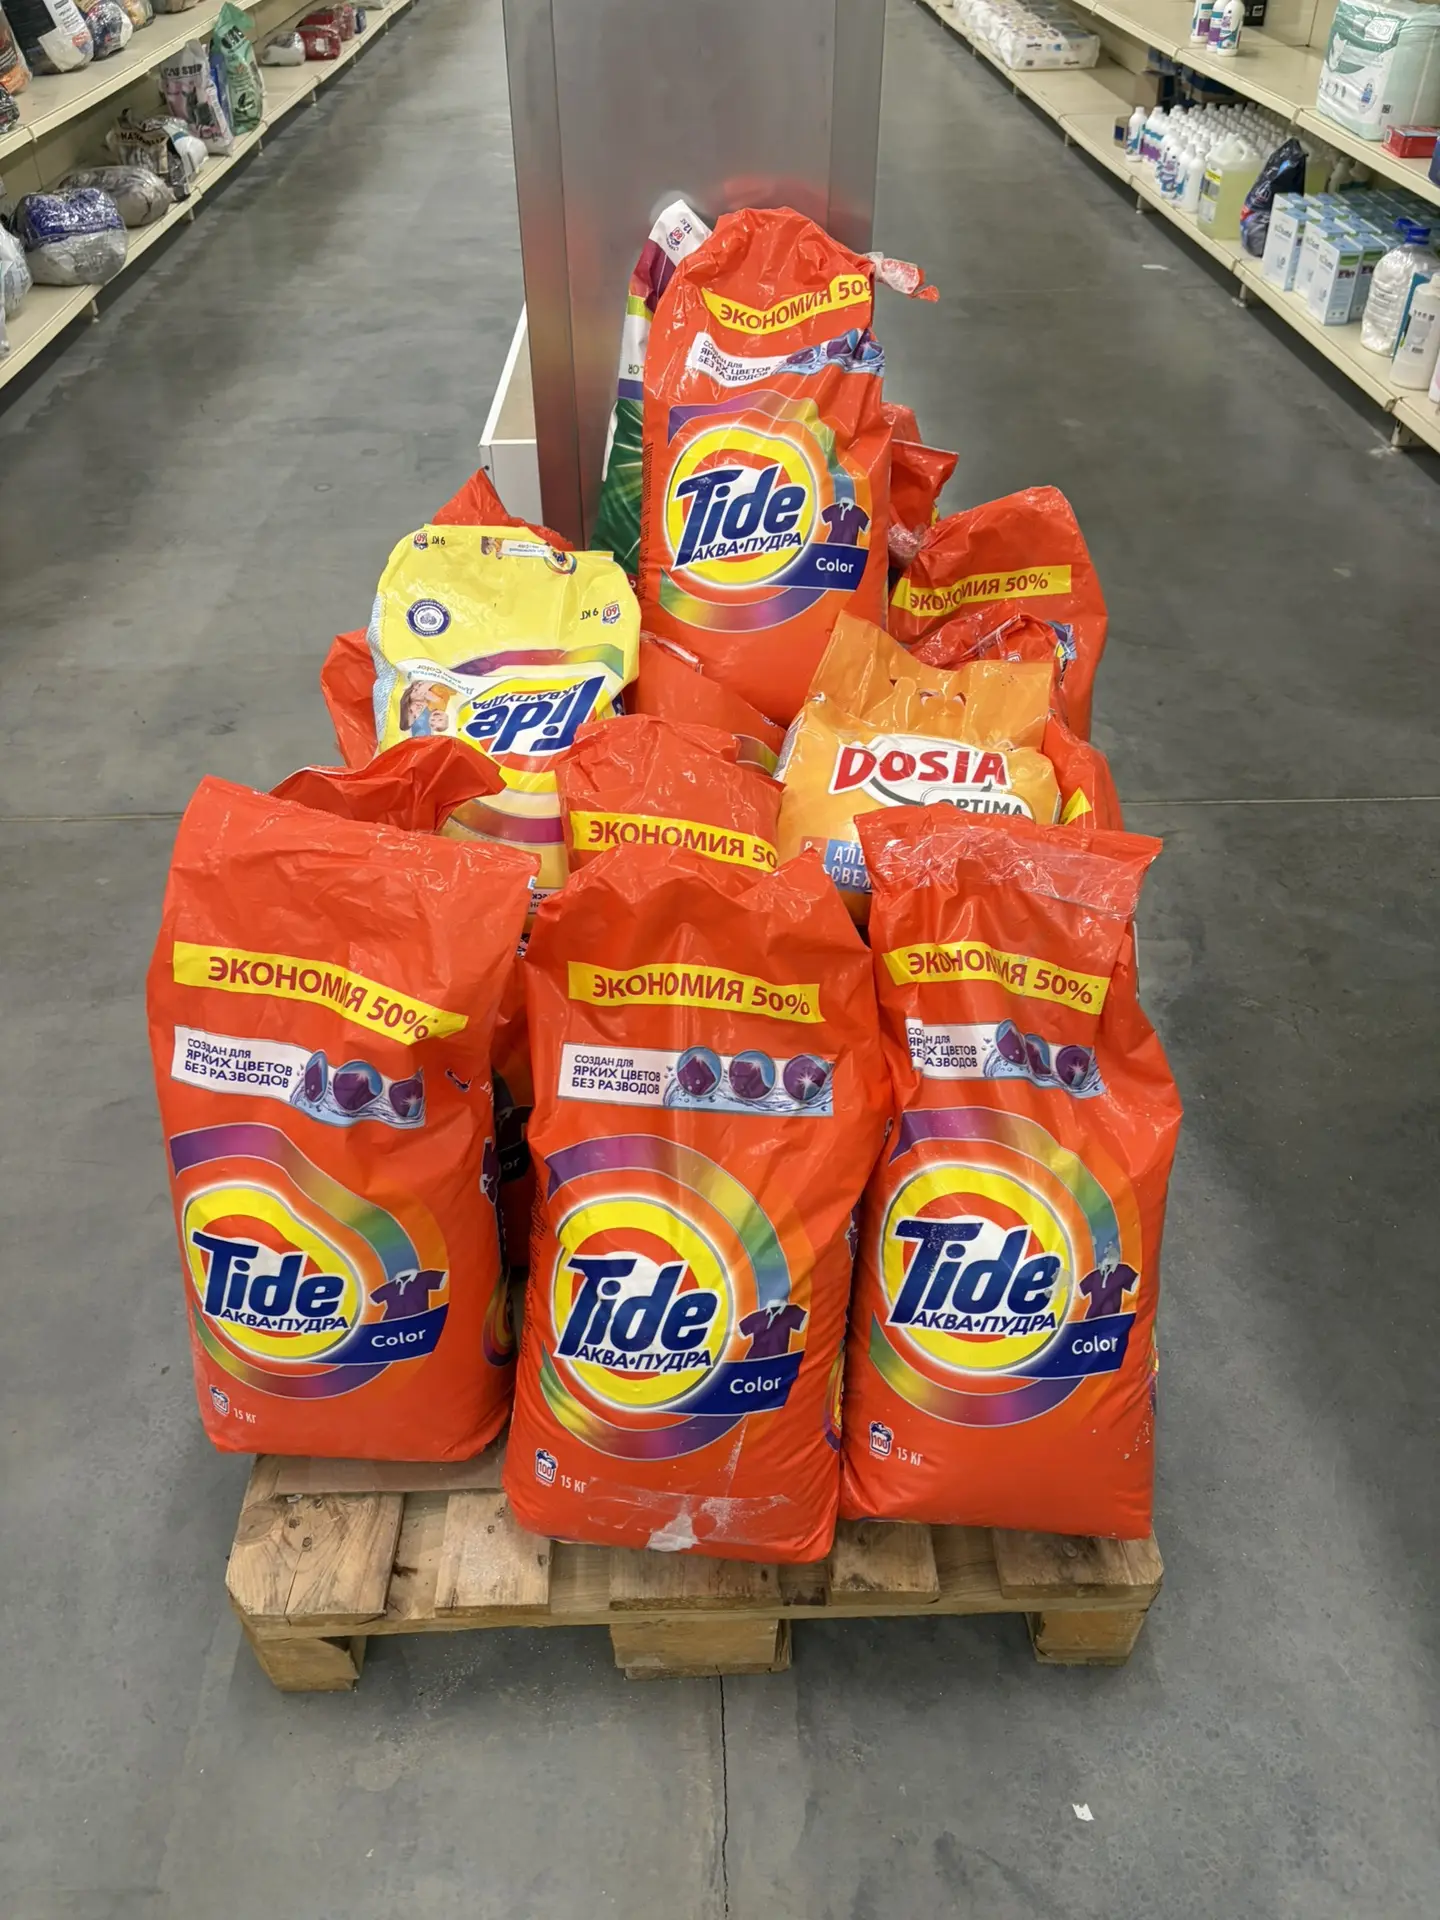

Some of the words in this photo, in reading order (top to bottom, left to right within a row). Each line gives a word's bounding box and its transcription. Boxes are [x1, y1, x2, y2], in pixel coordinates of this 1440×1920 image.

[719, 289, 833, 331] ЭКОНОМИЯ
[698, 355, 715, 369] БЕЗ
[727, 361, 743, 369] ДЛЯ
[730, 366, 771, 377] ЦВЕТОВ
[674, 465, 806, 569] Tide
[815, 557, 854, 575] Color
[910, 578, 1000, 611] ЭКОНОМИЯ
[1004, 572, 1049, 593] 50%
[592, 607, 599, 617] 9
[606, 606, 617, 617] 60
[465, 676, 606, 753] Tide
[833, 746, 1008, 792] DOSIA
[939, 799, 1023, 815] PTIMA
[588, 820, 745, 859] ЭКОНОМИЯ
[752, 843, 778, 868] 50
[833, 846, 865, 866] АЛЬ
[907, 949, 1028, 987] ЭКОНОМИЯ
[1033, 969, 1093, 1005] 50%
[208, 956, 369, 1013] ЭКОНОМИЯ
[366, 996, 429, 1039] 50%
[592, 972, 744, 1004] ЭКОНОМИЯ
[751, 987, 811, 1016] 50%
[187, 1038, 227, 1058] СОЗДАН
[229, 1048, 252, 1059] ДЛЯ
[935, 1035, 951, 1044] ДЛЯ
[574, 1054, 614, 1067] СОЗДАН
[615, 1058, 634, 1068] ДЛЯ
[940, 1046, 977, 1057] ЦВЕТОВ
[186, 1049, 233, 1070] ЯРКИХ
[234, 1057, 293, 1077] ЦВЕТОВ
[925, 1057, 978, 1069] АЗВОДОВ
[185, 1062, 208, 1078] БЕЗ
[209, 1068, 290, 1089] РАЗВОДОВ
[572, 1065, 618, 1080] ЯРКИХ
[620, 1069, 661, 1083] ЦВЕТОВ
[571, 1077, 596, 1089] БЕЗ
[598, 1079, 660, 1096] РАЗВОДОВ
[192, 1231, 345, 1317] Tide
[890, 1219, 1062, 1324] Tide
[558, 1257, 719, 1357] Tide
[370, 1327, 426, 1349] Color
[1071, 1337, 1118, 1356] Color
[729, 1375, 782, 1395] Color
[233, 1408, 244, 1420] 15
[873, 1435, 888, 1450] 100
[896, 1446, 908, 1461] 15
[538, 1461, 552, 1477] 100
[560, 1474, 572, 1489] 15
